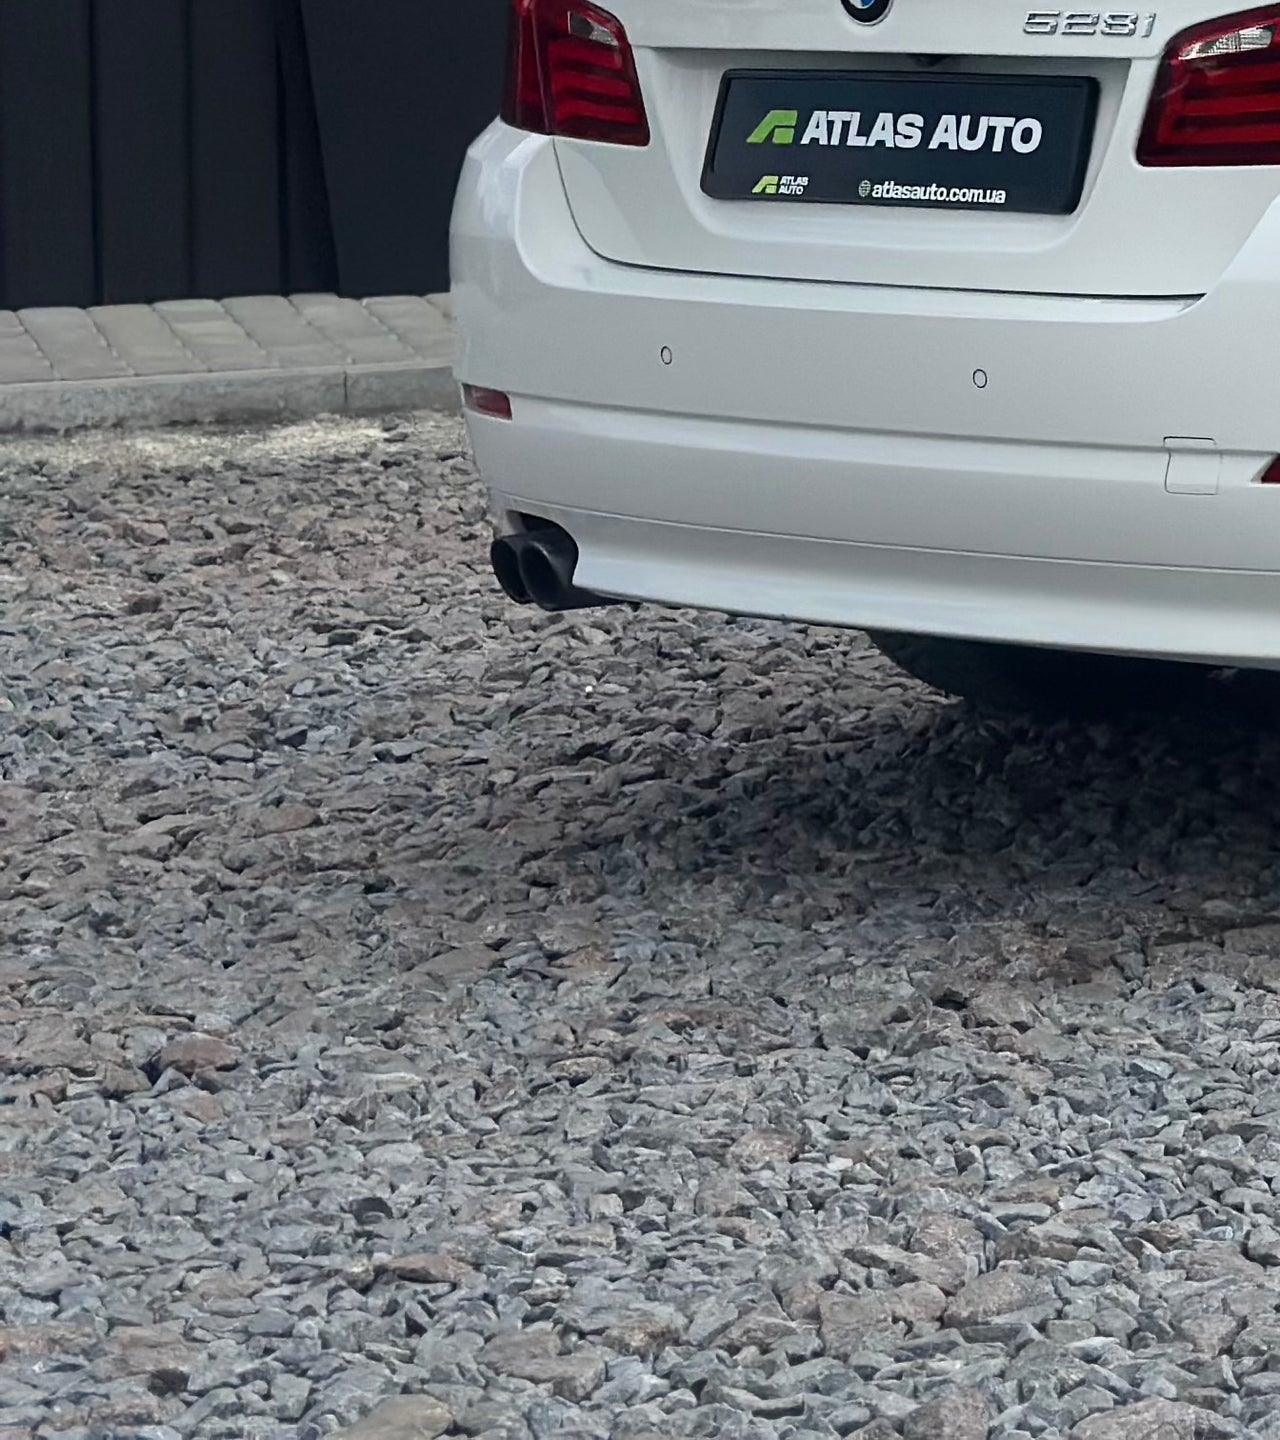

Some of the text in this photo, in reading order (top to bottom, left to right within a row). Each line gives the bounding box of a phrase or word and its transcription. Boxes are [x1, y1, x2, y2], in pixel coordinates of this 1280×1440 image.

[1023, 10, 1157, 38] 528i
[800, 110, 1043, 154] ATLAS AUTO
[777, 184, 804, 195] AUTO
[778, 175, 809, 186] ATLAS
[871, 180, 1007, 204] atlasauto.com.ua
